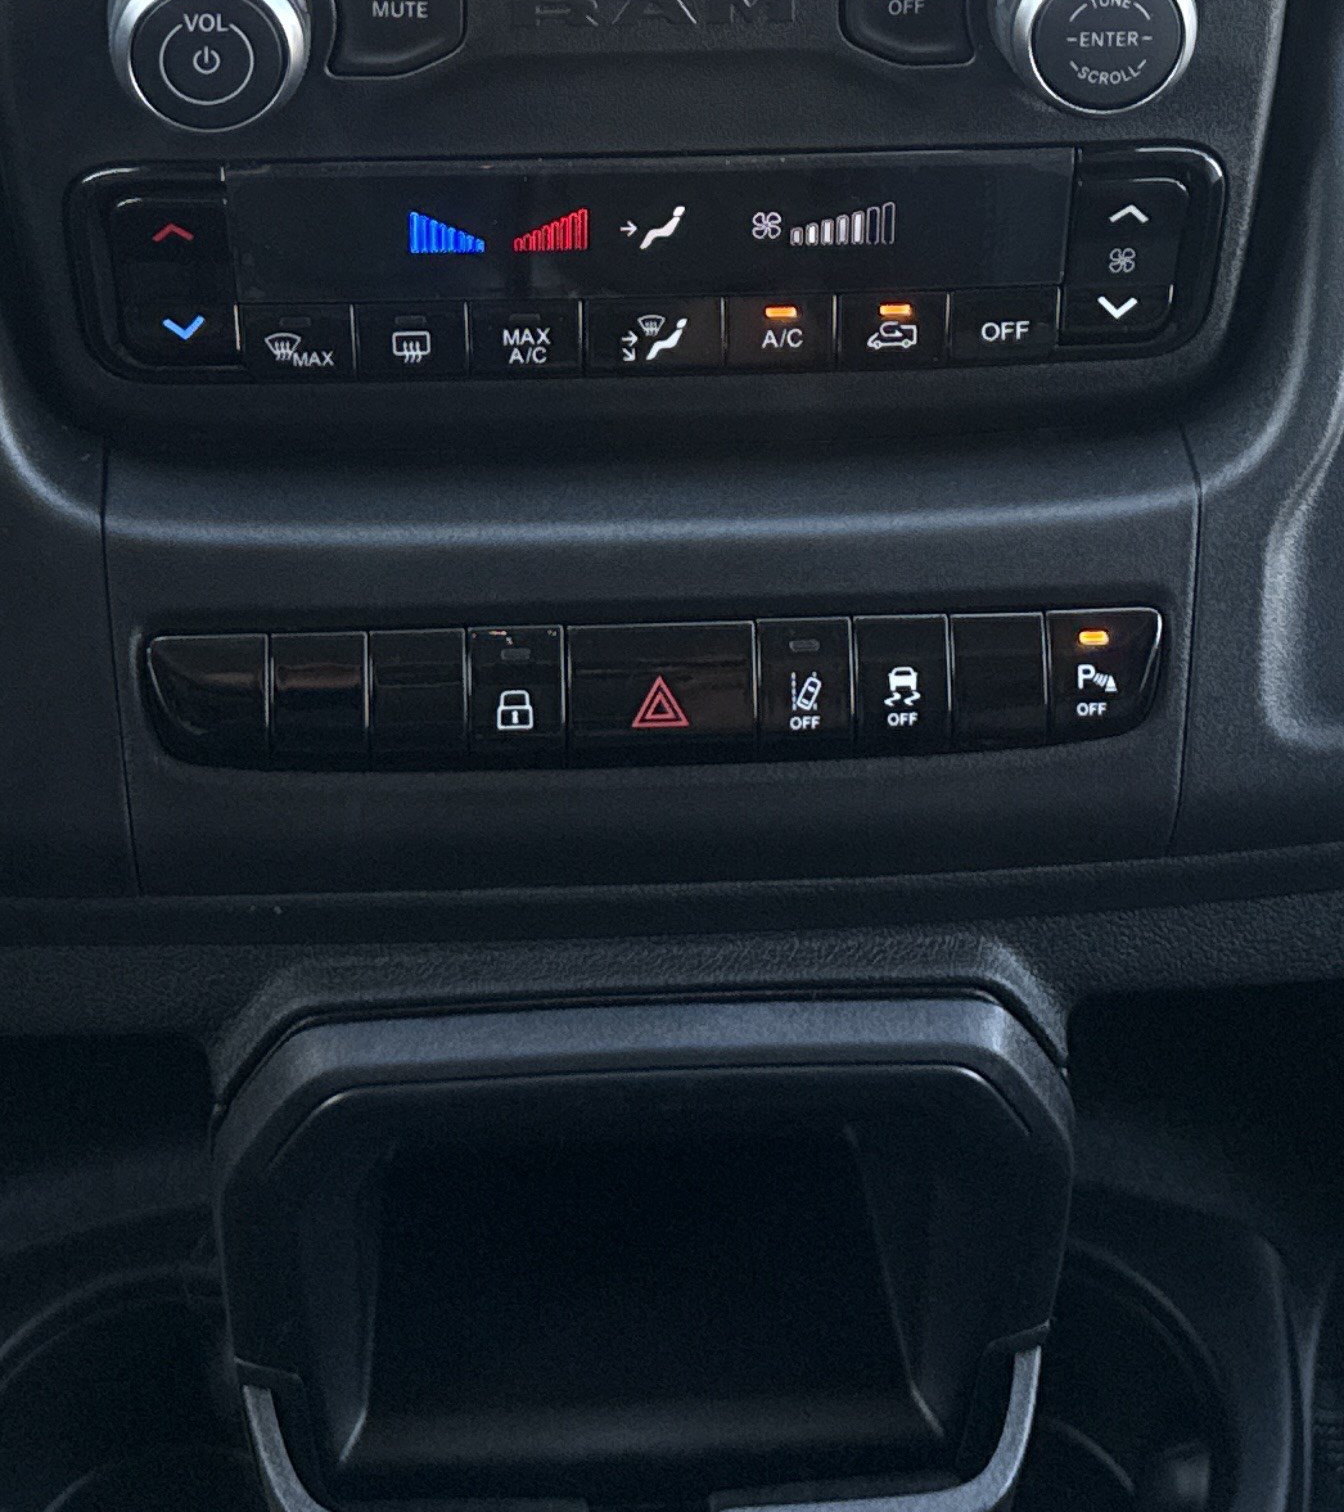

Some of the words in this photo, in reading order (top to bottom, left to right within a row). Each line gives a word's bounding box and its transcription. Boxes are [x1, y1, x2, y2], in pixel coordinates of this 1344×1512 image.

[372, 0, 429, 19] MUTE
[183, 13, 229, 33] VOL
[1080, 30, 1140, 48] ENTER
[1077, 63, 1142, 85] SCROLL
[502, 327, 551, 345] MAX
[762, 328, 803, 349] A/C
[981, 321, 1030, 341] OFF
[293, 350, 335, 367] MAX
[508, 346, 547, 365] A/C
[1076, 702, 1107, 716] OFF
[789, 716, 821, 730] OFF
[887, 712, 918, 726] OFF
